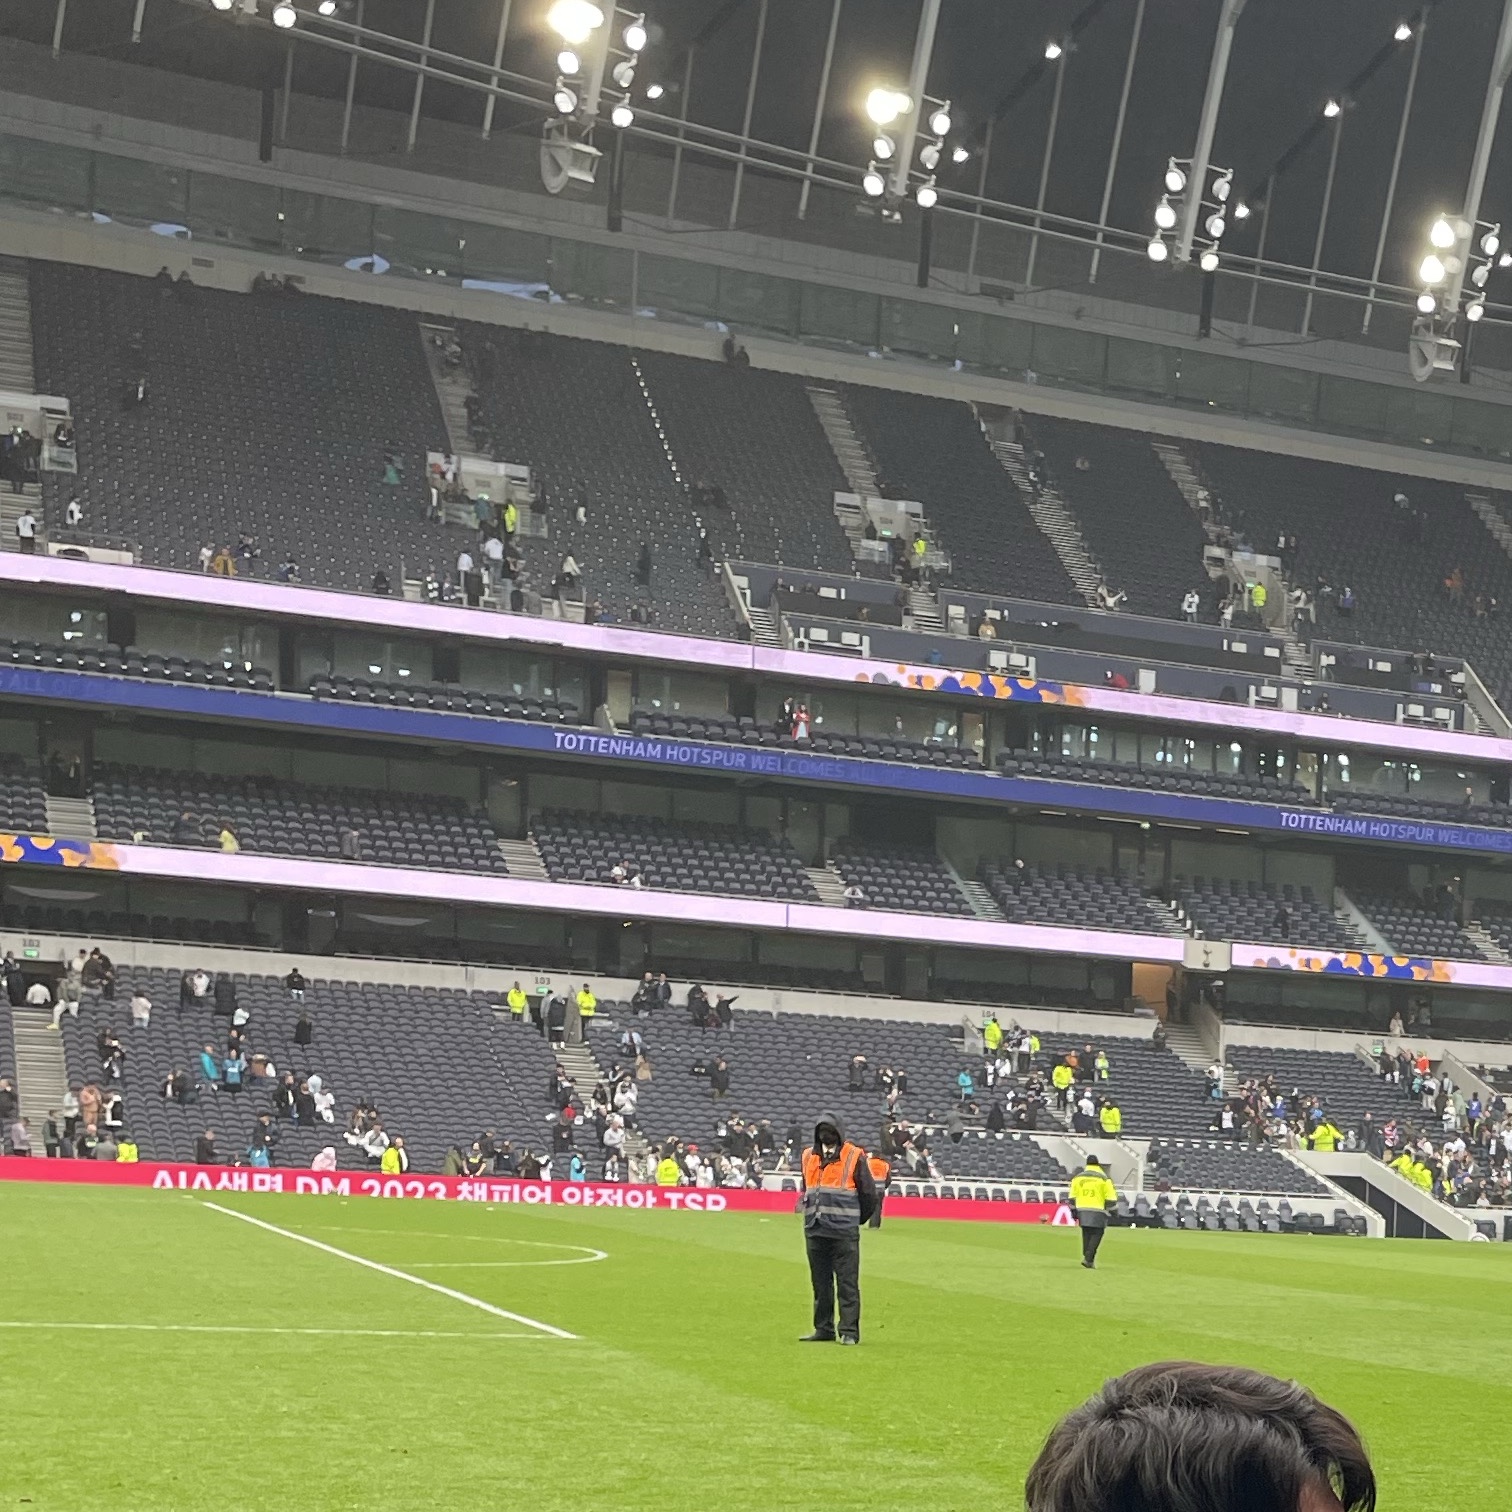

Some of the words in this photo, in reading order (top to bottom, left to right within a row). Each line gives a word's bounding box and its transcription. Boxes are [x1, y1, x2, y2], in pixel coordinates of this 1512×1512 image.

[554, 732, 661, 759] TOTTENHAM
[666, 745, 746, 768] HOTSPUR
[751, 754, 845, 778] WELCOMES
[1280, 812, 1367, 835] TOTTENHAM
[1369, 822, 1434, 842] HOTSPUR
[1438, 828, 1512, 850] WELCOMES
[296, 1176, 350, 1196] DM
[361, 1179, 447, 1200] 2023
